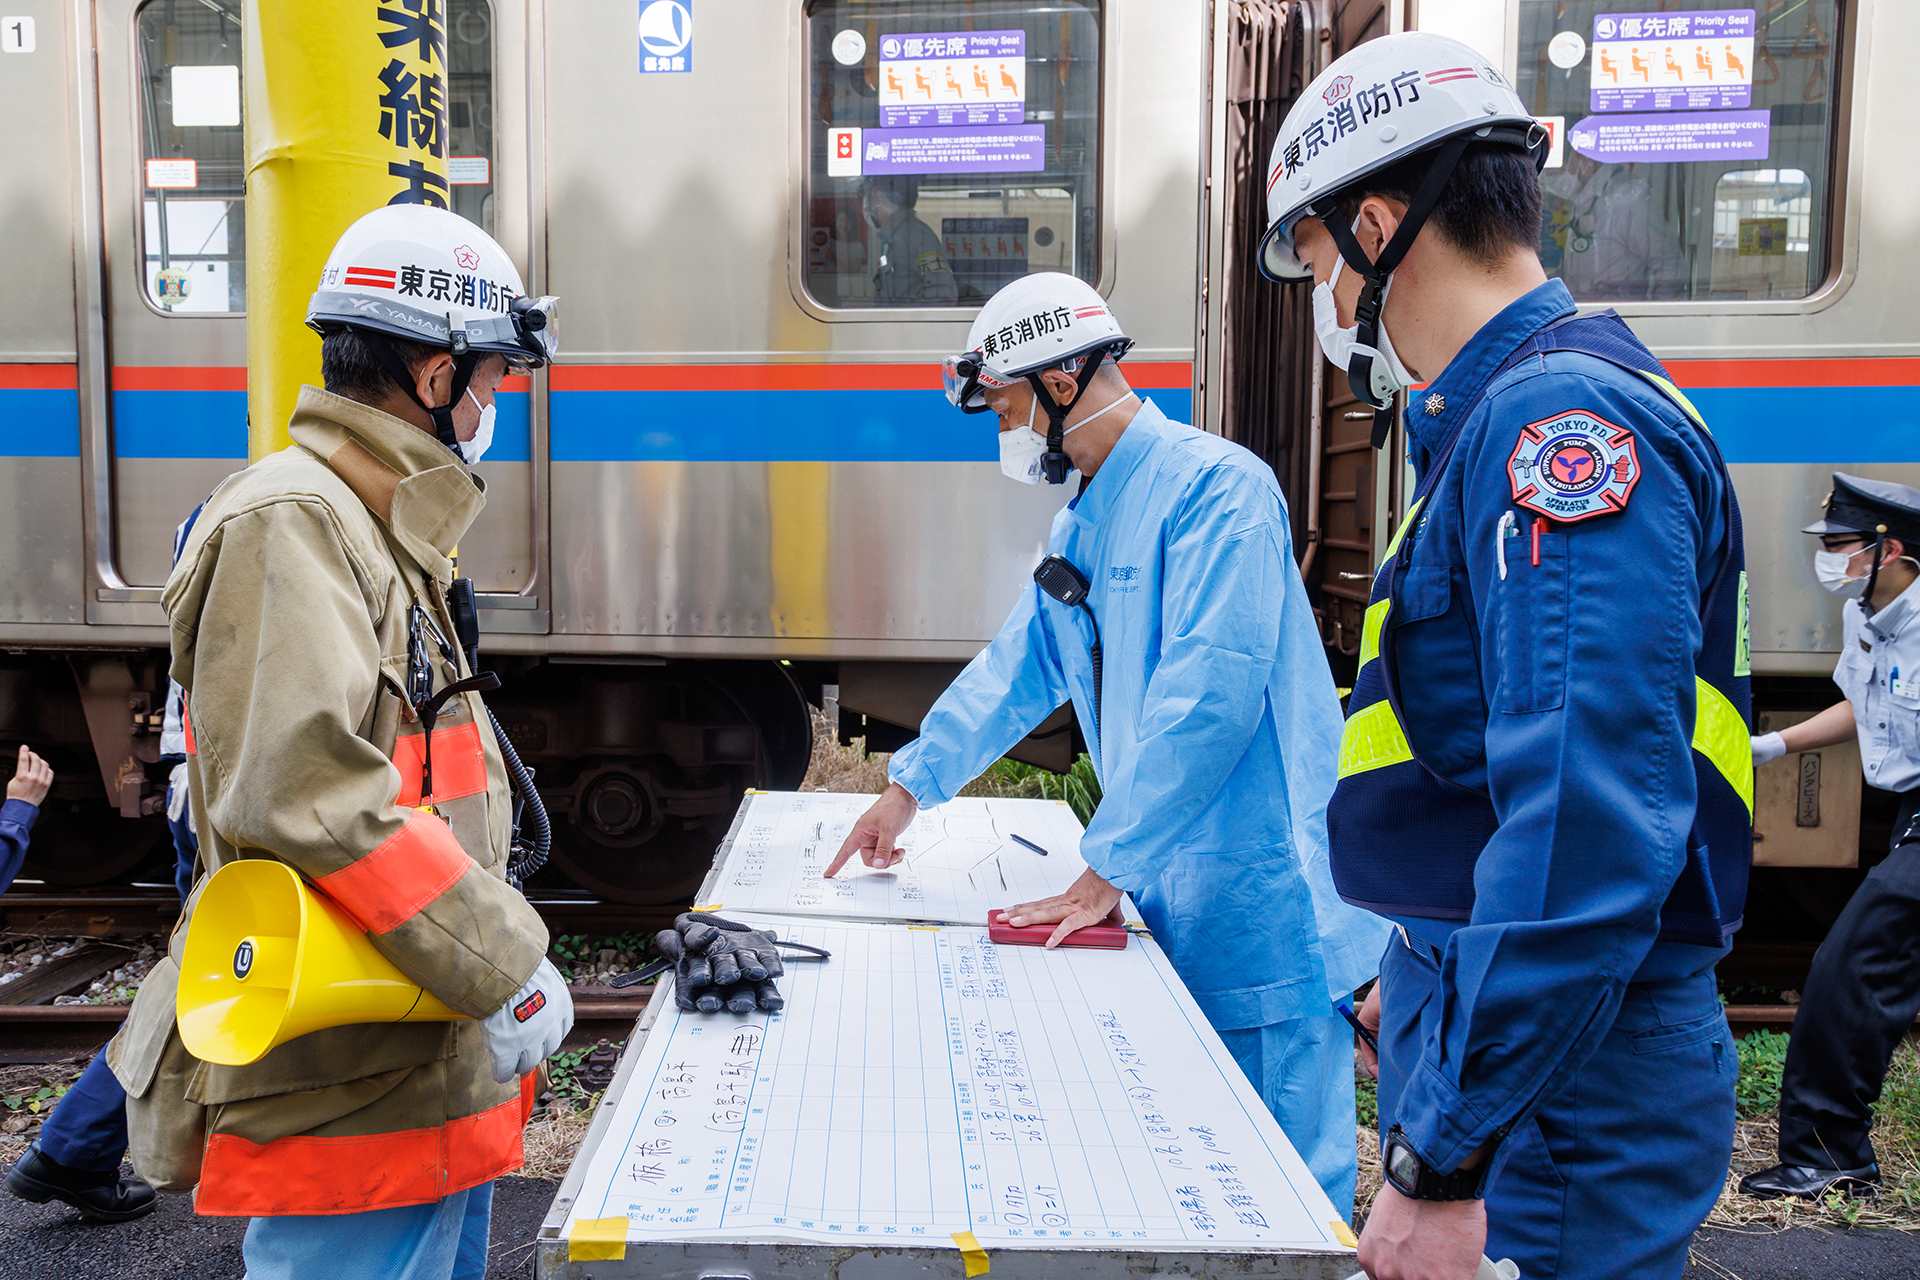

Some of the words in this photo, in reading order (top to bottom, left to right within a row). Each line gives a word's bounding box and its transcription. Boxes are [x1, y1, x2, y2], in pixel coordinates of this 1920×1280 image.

[1619, 16, 1690, 38] 優先席
[1695, 16, 1725, 26] Priority
[1728, 15, 1749, 25] Seat
[12, 22, 22, 47] 1
[971, 37, 999, 46] Priority
[1001, 36, 1020, 45] Seat
[903, 37, 967, 57] 優先席
[644, 56, 685, 71] 優先席
[1331, 82, 1346, 99] 小
[1282, 70, 1421, 180] 東京消防庁
[461, 252, 473, 265] 大
[398, 264, 515, 316] 東京消防庁
[983, 306, 1071, 360] 東京消防庁
[1548, 420, 1588, 435] TOKYO
[1590, 426, 1608, 440] F.D.
[1563, 440, 1588, 448] PUMP
[1543, 447, 1558, 476] SUPPORT
[1592, 450, 1602, 479] LADDER
[1547, 476, 1595, 491] AMBULANCE
[1545, 497, 1590, 507] APPARATUS
[1545, 503, 1588, 512] OPERATOR
[656, 1061, 699, 1099] 高島平
[962, 1110, 977, 1141] 性別・年齢
[628, 1139, 672, 1185] 板橋
